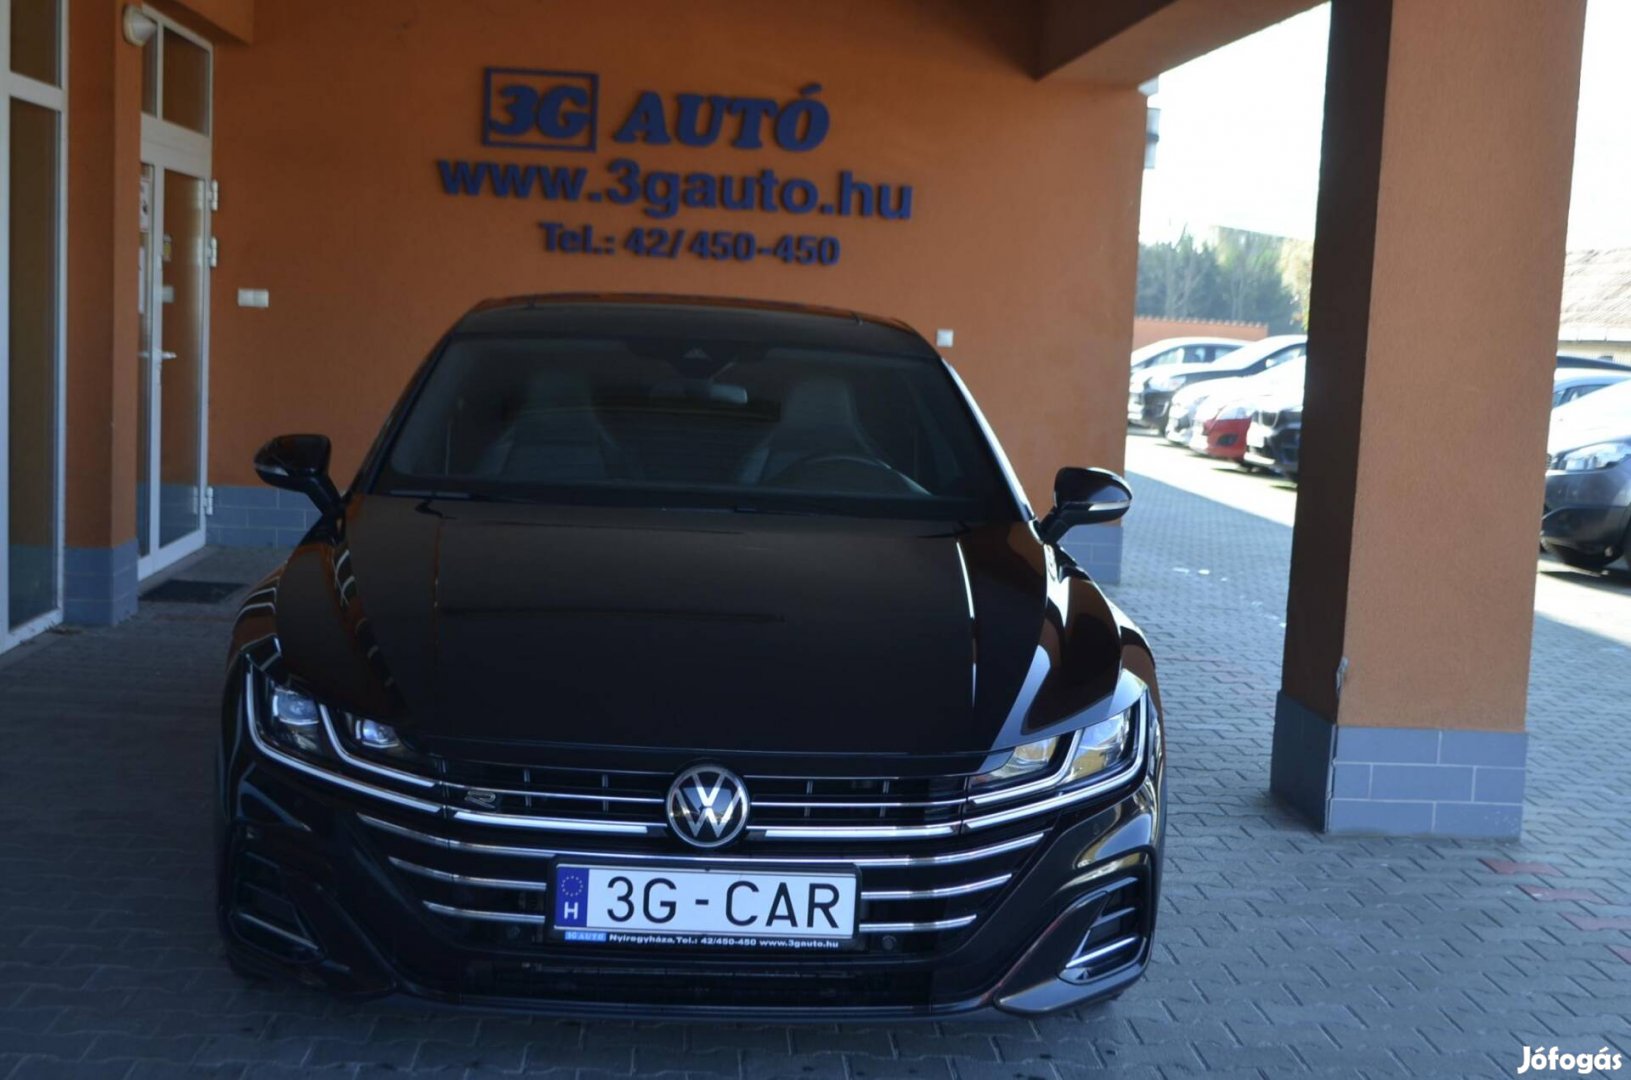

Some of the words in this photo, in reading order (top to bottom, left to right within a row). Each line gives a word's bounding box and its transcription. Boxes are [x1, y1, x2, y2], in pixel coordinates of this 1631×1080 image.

[489, 84, 591, 139] 3G
[612, 83, 830, 152] AUTÓ
[436, 157, 912, 219] www.3gauto.hu
[539, 221, 615, 255] Tel.:
[563, 902, 579, 920] H
[606, 875, 677, 924] 3G
[725, 880, 840, 929] CAR
[759, 939, 839, 948] www.3gauto.hu
